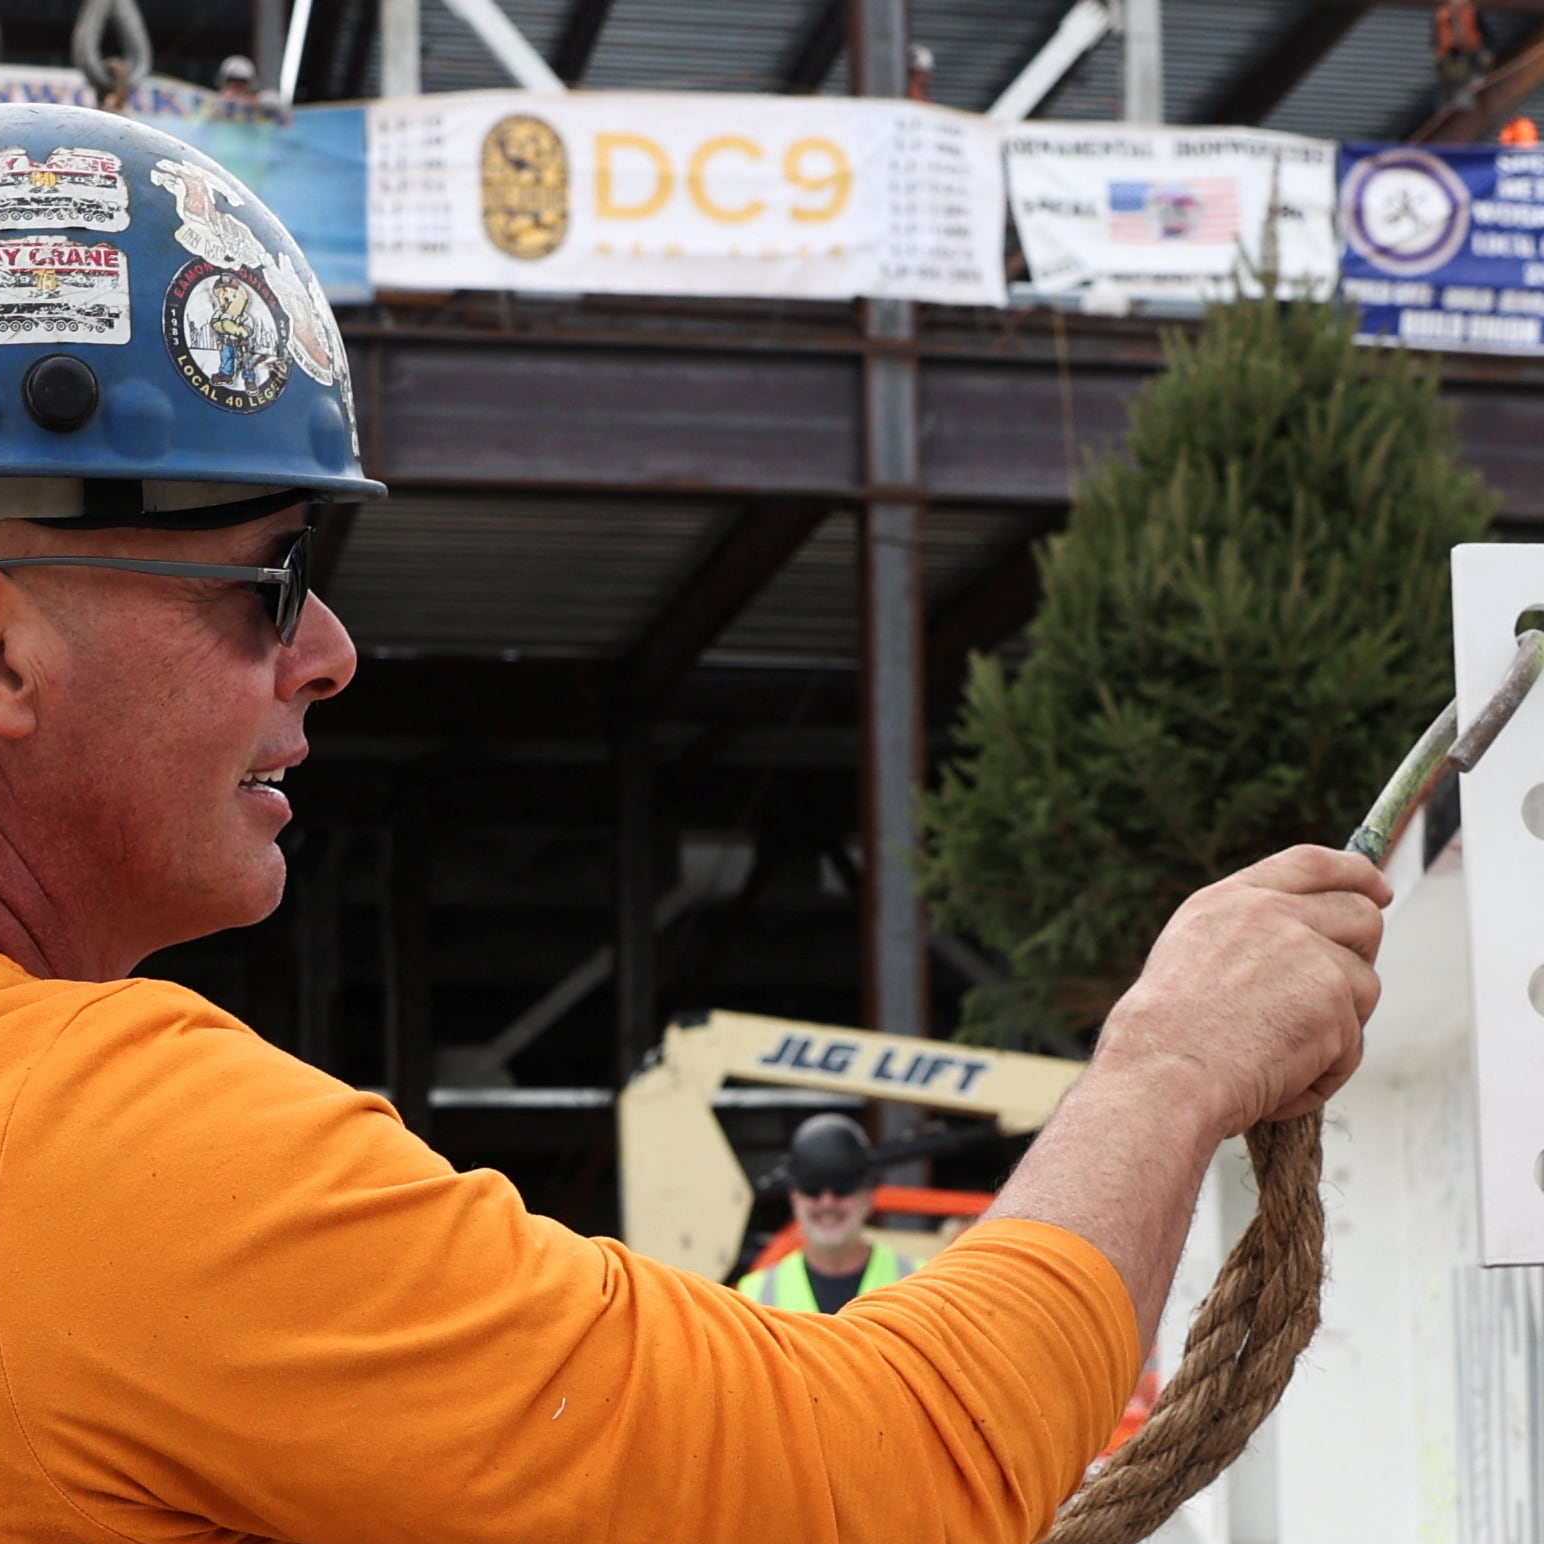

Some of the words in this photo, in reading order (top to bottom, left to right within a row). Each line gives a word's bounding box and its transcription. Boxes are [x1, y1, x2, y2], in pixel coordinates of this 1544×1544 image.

[593, 131, 853, 224] DC9
[28, 248, 120, 269] CRANE
[170, 308, 180, 346] 1983
[177, 354, 219, 400] LOCAL
[225, 395, 244, 408] 40
[759, 1033, 862, 1075] JLG
[871, 1047, 989, 1094] LIFT
